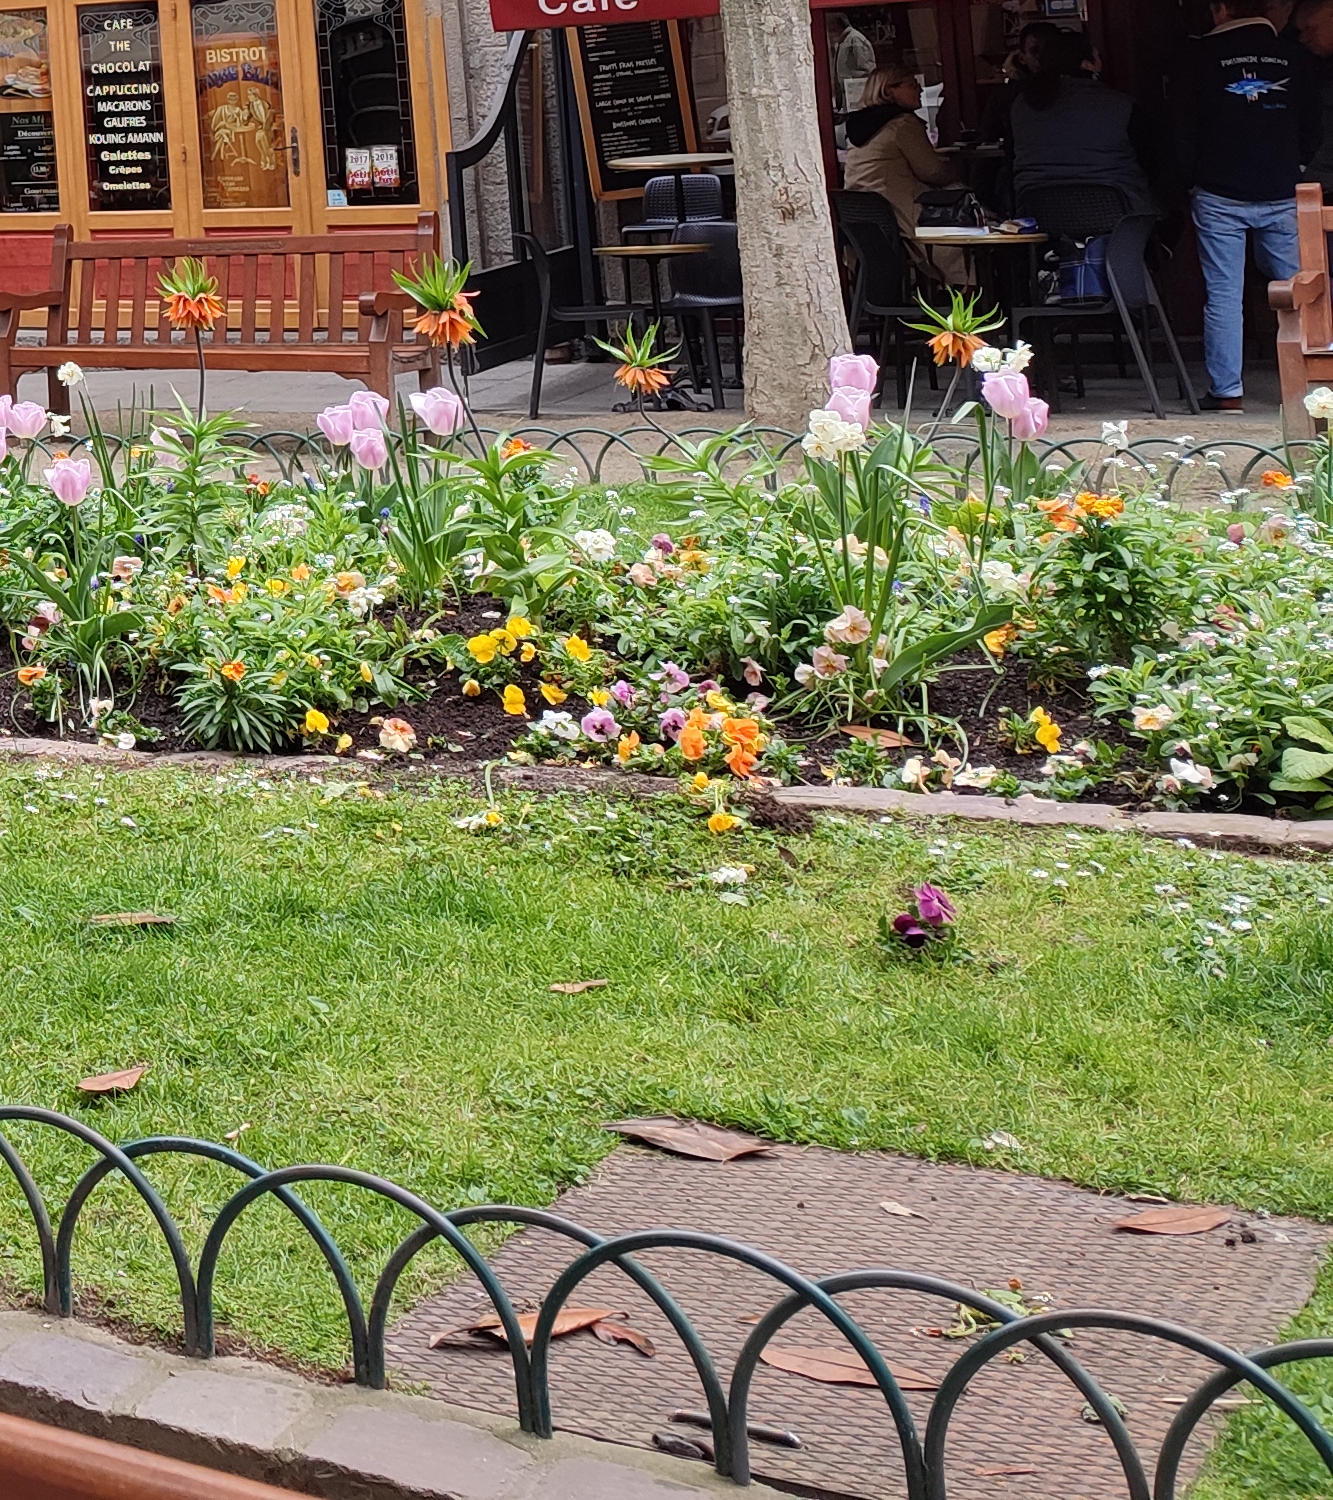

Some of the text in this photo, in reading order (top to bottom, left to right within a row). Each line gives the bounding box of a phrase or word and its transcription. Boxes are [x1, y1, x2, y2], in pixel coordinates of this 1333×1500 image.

[104, 18, 133, 30] CAFE
[109, 40, 131, 52] THE
[205, 46, 267, 63] BISTROT
[91, 61, 152, 74] CHOCOLAT
[599, 63, 618, 72] FRUITS
[619, 60, 634, 70] FRAIS
[86, 83, 159, 97] CAPPUCCINO
[97, 100, 151, 112] MACARONS
[11, 116, 29, 125] Nos
[103, 116, 147, 128] GAUFRES
[88, 132, 164, 144] KOUING AMANN
[100, 150, 152, 161] Galettes
[102, 181, 151, 191] Omelettes
